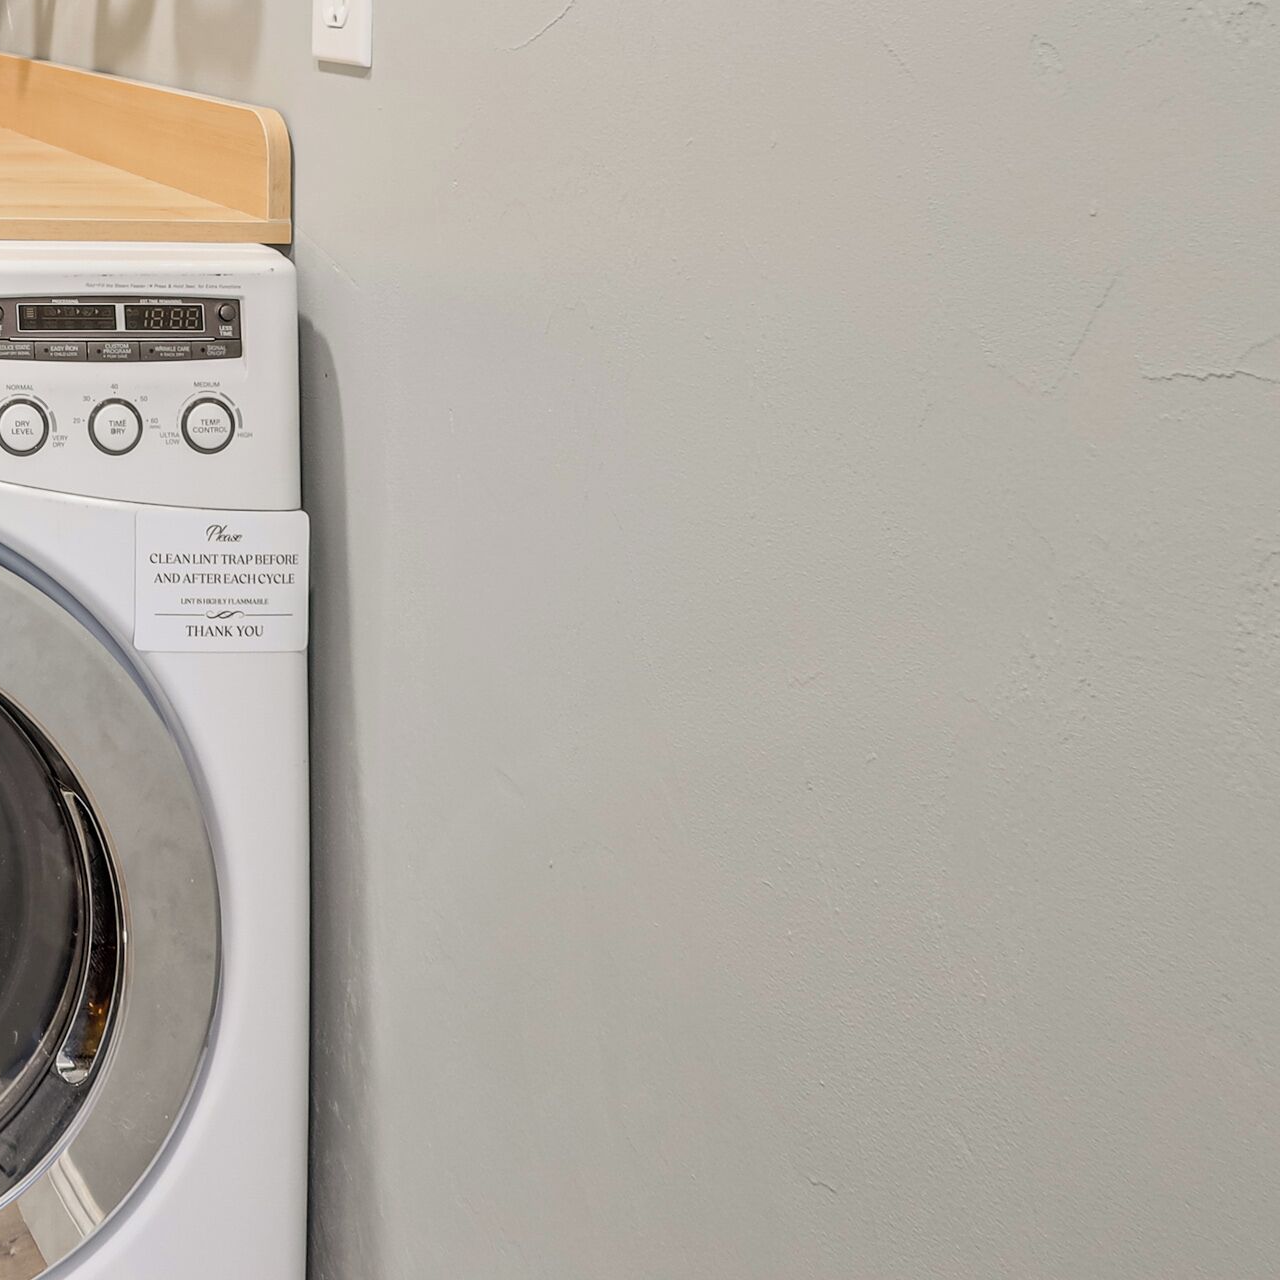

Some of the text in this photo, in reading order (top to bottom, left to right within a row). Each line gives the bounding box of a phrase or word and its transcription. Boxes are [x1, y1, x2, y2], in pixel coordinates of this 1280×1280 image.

[206, 524, 243, 542] Please
[149, 553, 299, 565] CLEAN LINT TRAP BEFORE
[154, 573, 295, 585] AND AFTER EACH CYCLE
[185, 625, 264, 637] THANK YOU
